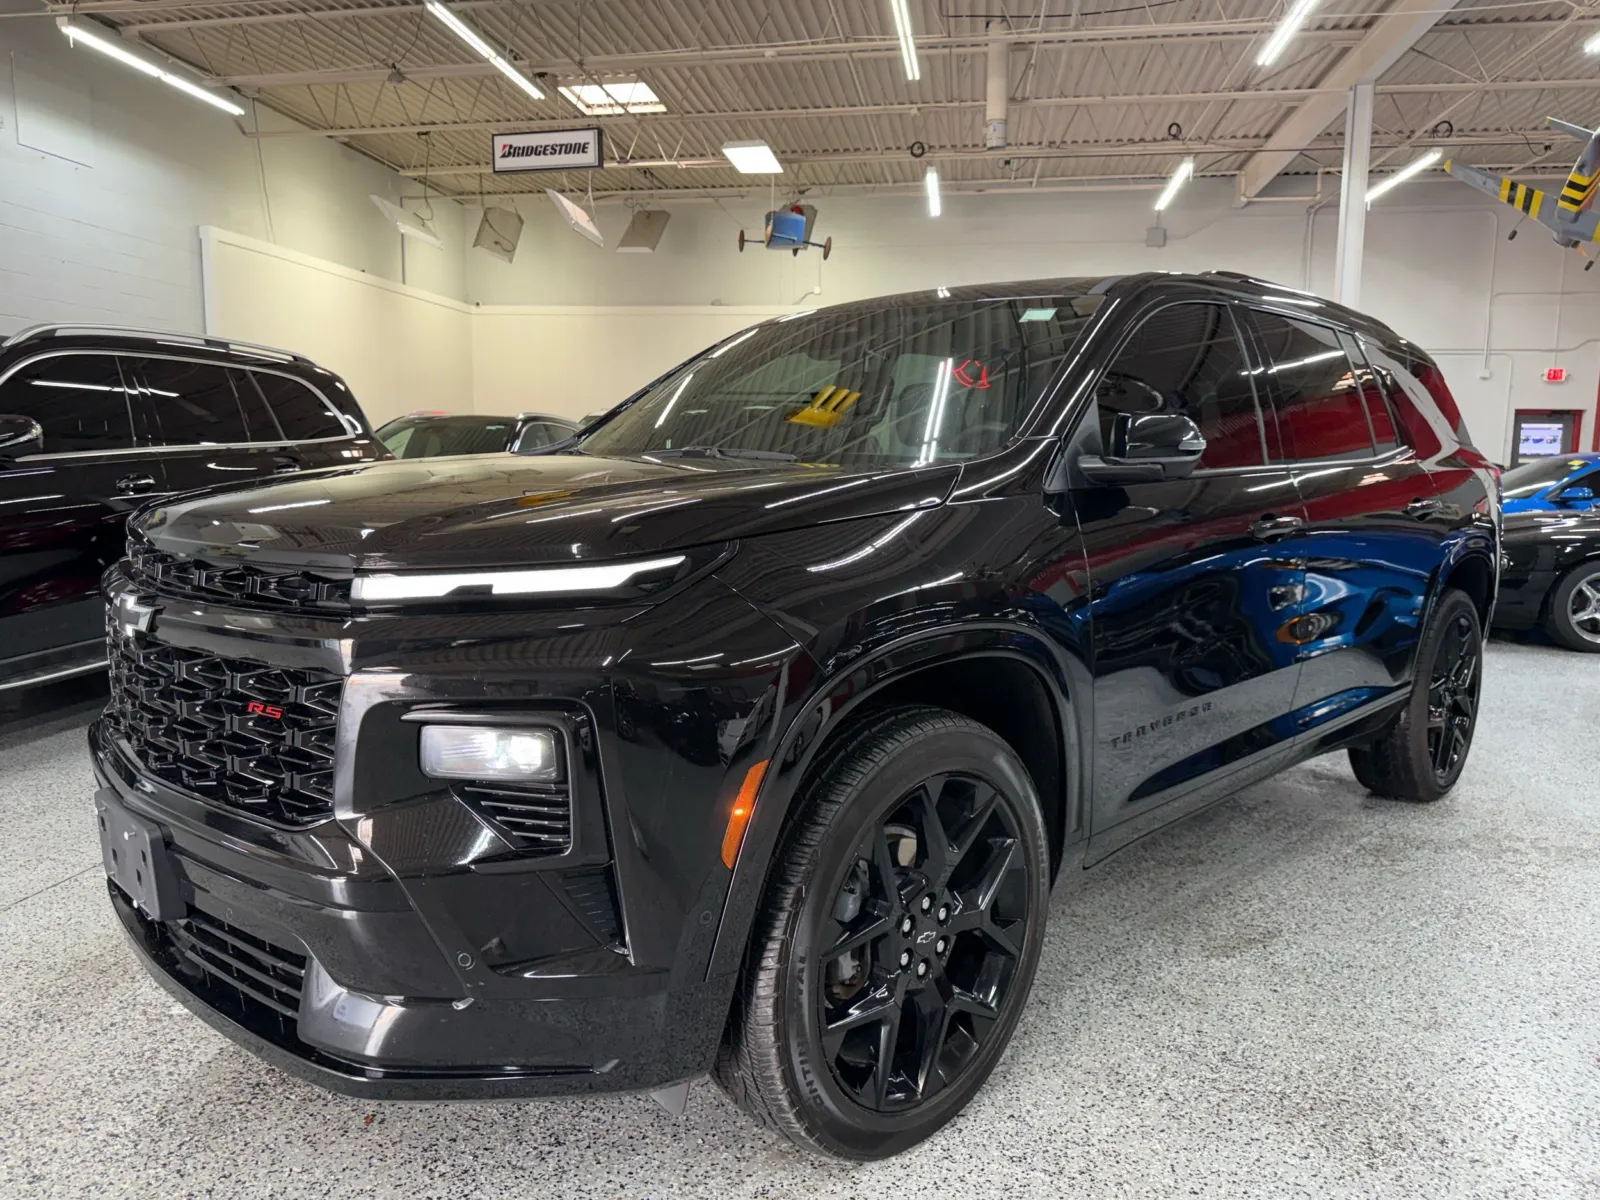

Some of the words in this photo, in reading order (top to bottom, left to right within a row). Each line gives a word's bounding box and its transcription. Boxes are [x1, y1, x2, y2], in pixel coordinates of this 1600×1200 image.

[500, 142, 590, 158] BRIDGESTONE
[1547, 368, 1564, 381] EXIT
[248, 701, 282, 719] RS
